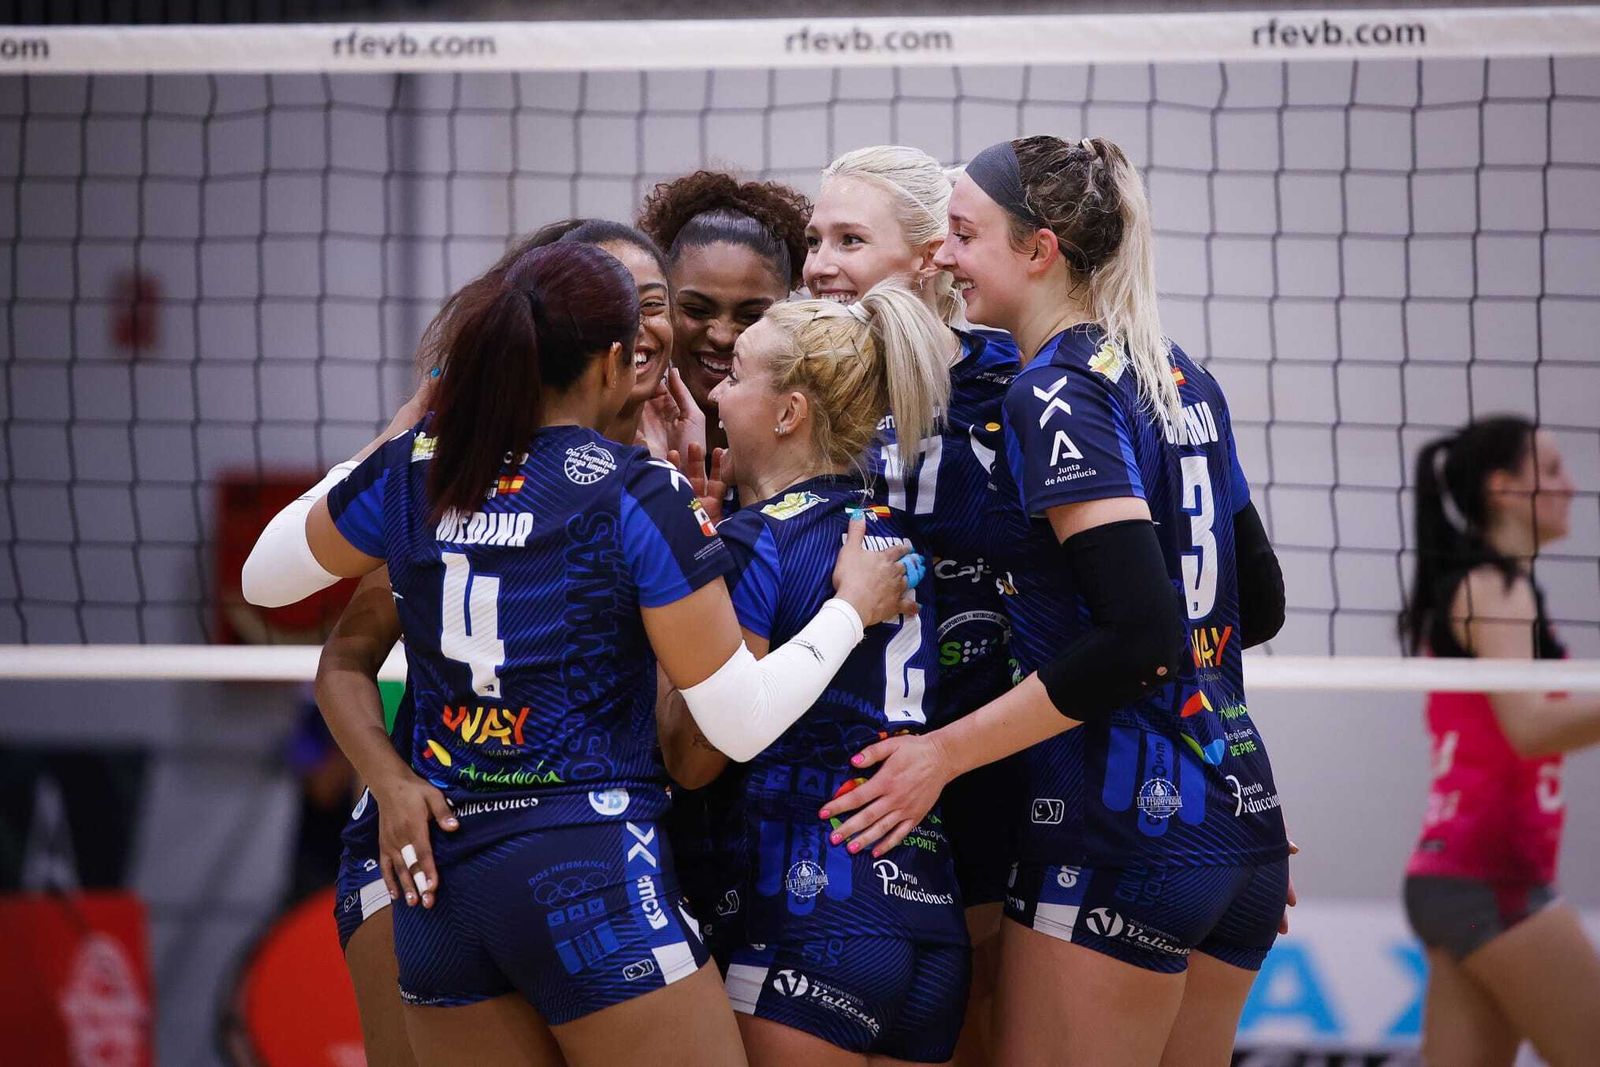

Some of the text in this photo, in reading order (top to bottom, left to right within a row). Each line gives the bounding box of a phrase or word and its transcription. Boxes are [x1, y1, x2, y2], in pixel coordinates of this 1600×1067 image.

[331, 31, 497, 57] rfevb.com
[784, 29, 954, 53] rfevb.com
[1252, 17, 1427, 47] rfevb.com
[881, 434, 943, 515] 17
[1044, 467, 1097, 486] de Andalucía
[1057, 463, 1080, 475] Junta
[435, 506, 534, 548] MEDINA
[1179, 455, 1219, 620] 3
[440, 551, 505, 699] 4
[882, 586, 928, 724] 2
[443, 704, 531, 746] WAY
[903, 836, 937, 852] EPORTE
[810, 984, 881, 1034] Valiente
